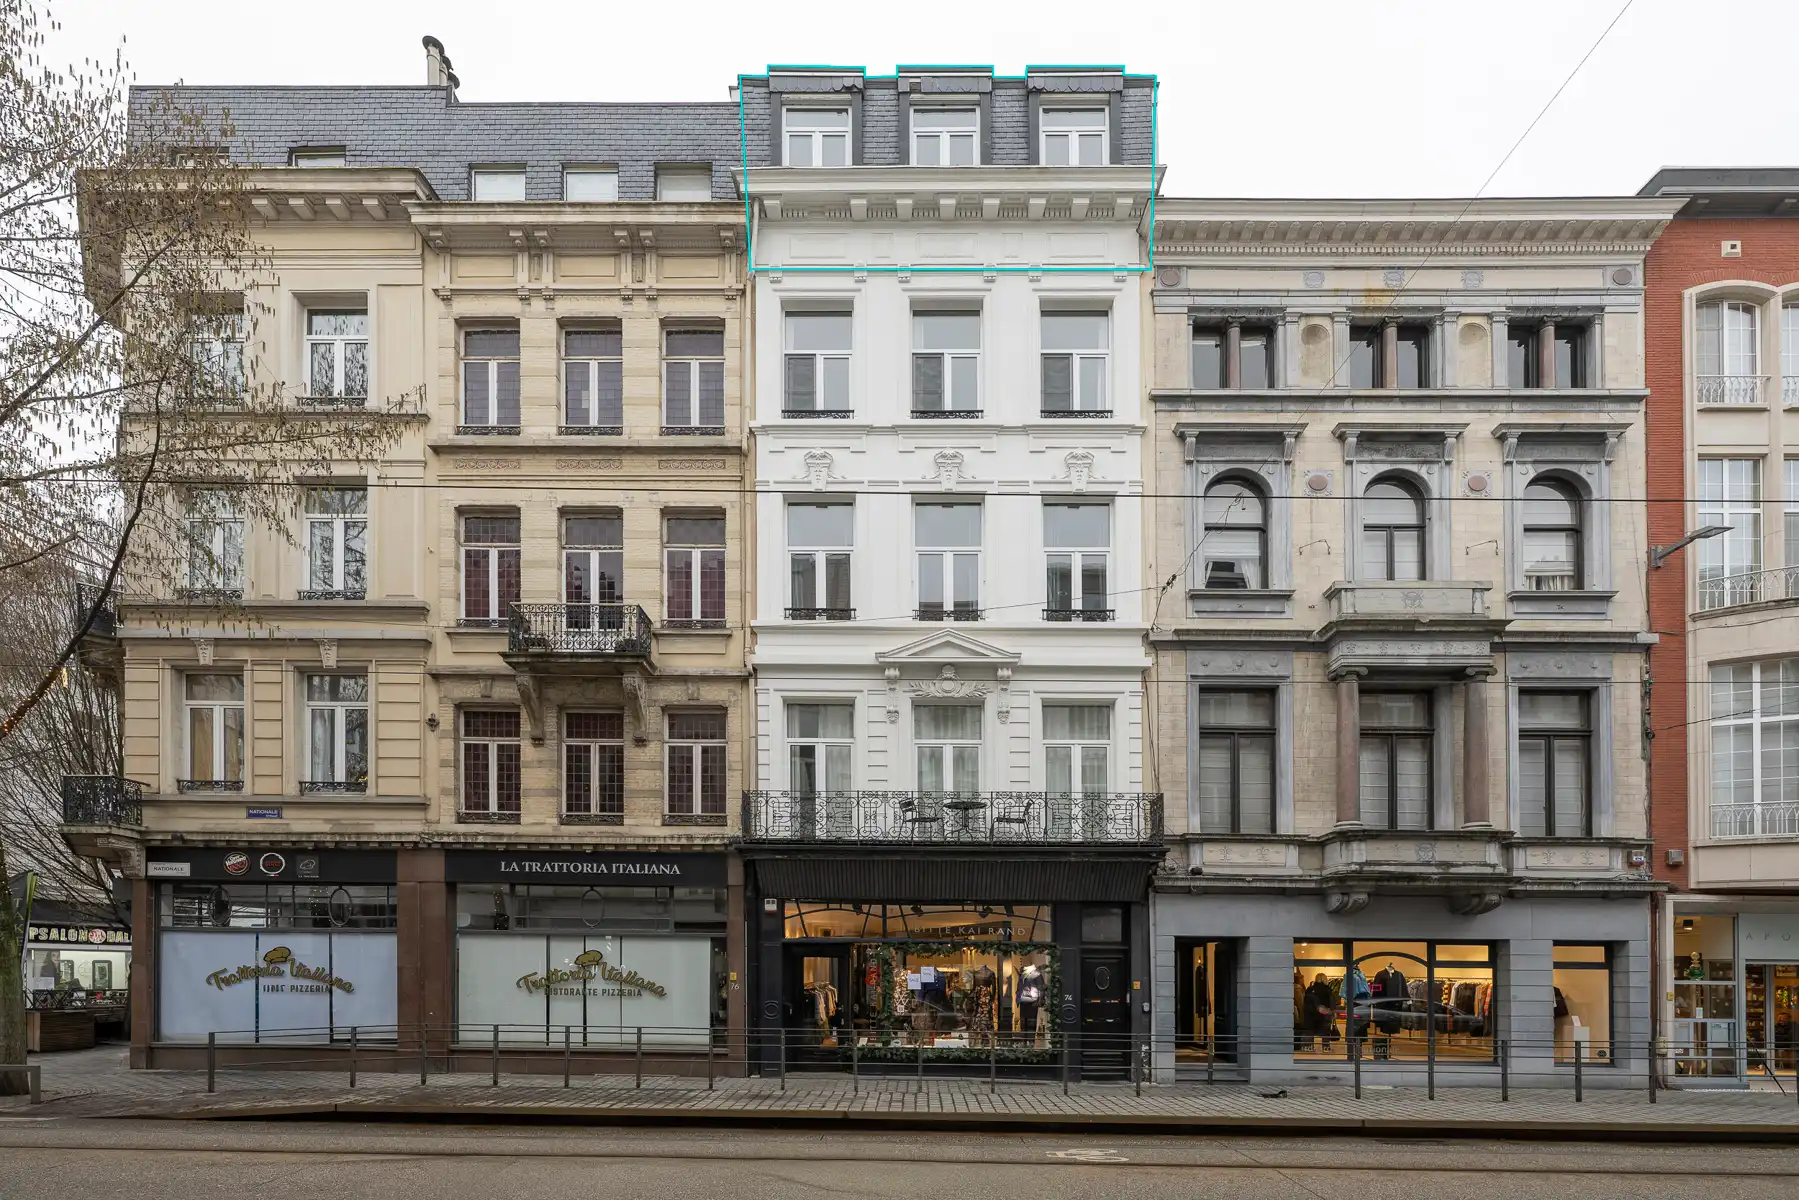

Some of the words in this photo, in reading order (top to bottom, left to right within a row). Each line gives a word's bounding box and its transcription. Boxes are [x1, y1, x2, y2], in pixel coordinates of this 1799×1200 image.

[501, 861, 519, 872] LA
[522, 862, 608, 874] TRATTORIA
[612, 863, 681, 875] ITALIANA
[106, 930, 132, 943] DAL
[958, 926, 981, 934] KAI
[988, 927, 1026, 936] RAND
[516, 964, 597, 994] Trattoria
[600, 961, 667, 997] Italiana
[290, 984, 331, 993] PIZZERIA
[602, 988, 642, 997] PIZZERIA
